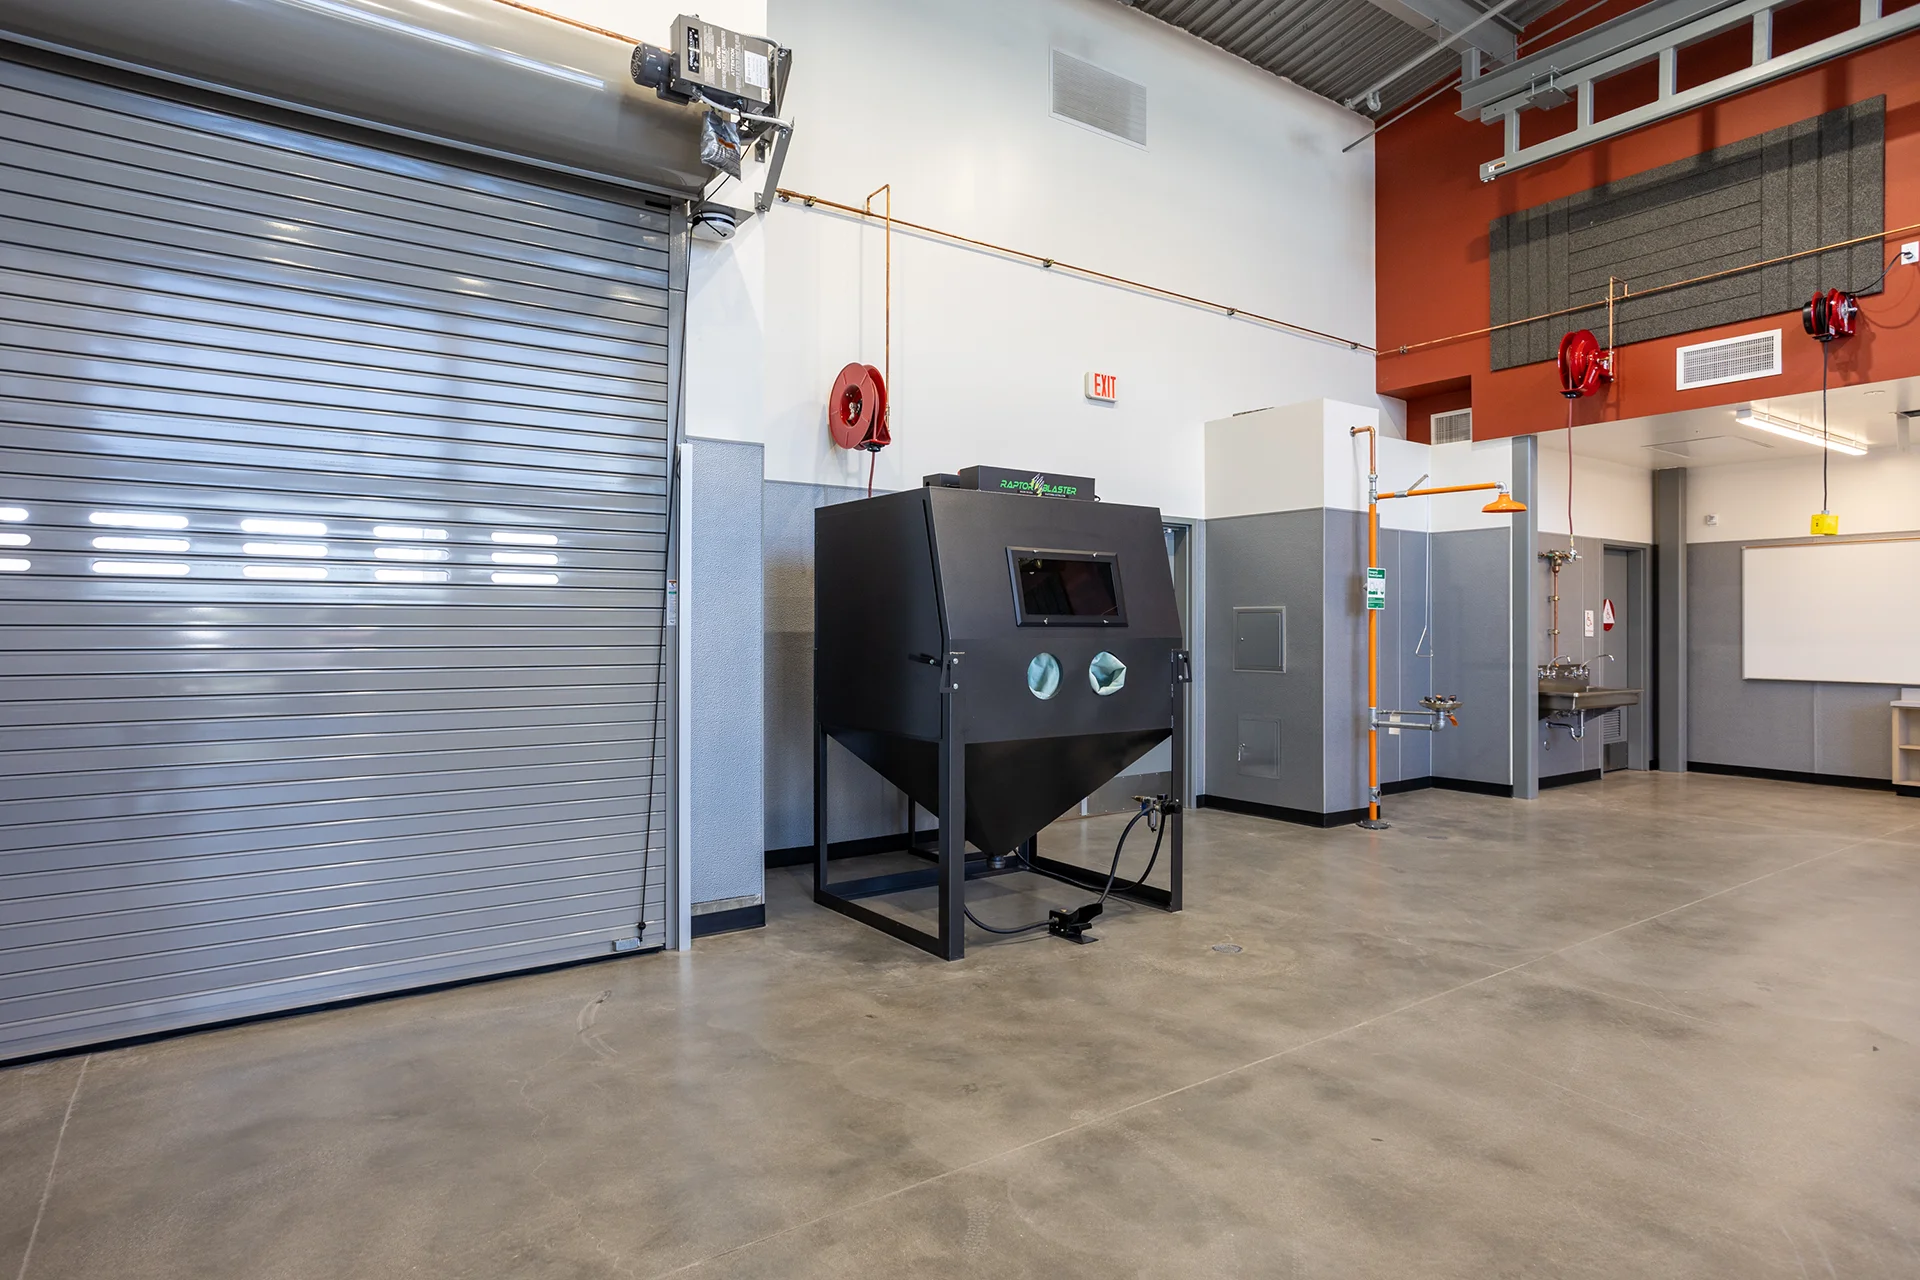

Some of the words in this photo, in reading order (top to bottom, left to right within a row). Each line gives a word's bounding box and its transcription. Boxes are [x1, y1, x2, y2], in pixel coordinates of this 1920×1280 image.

[1094, 372, 1117, 399] EXIT
[1000, 479, 1034, 491] RAPTOR
[1042, 483, 1077, 495] BLASTER
